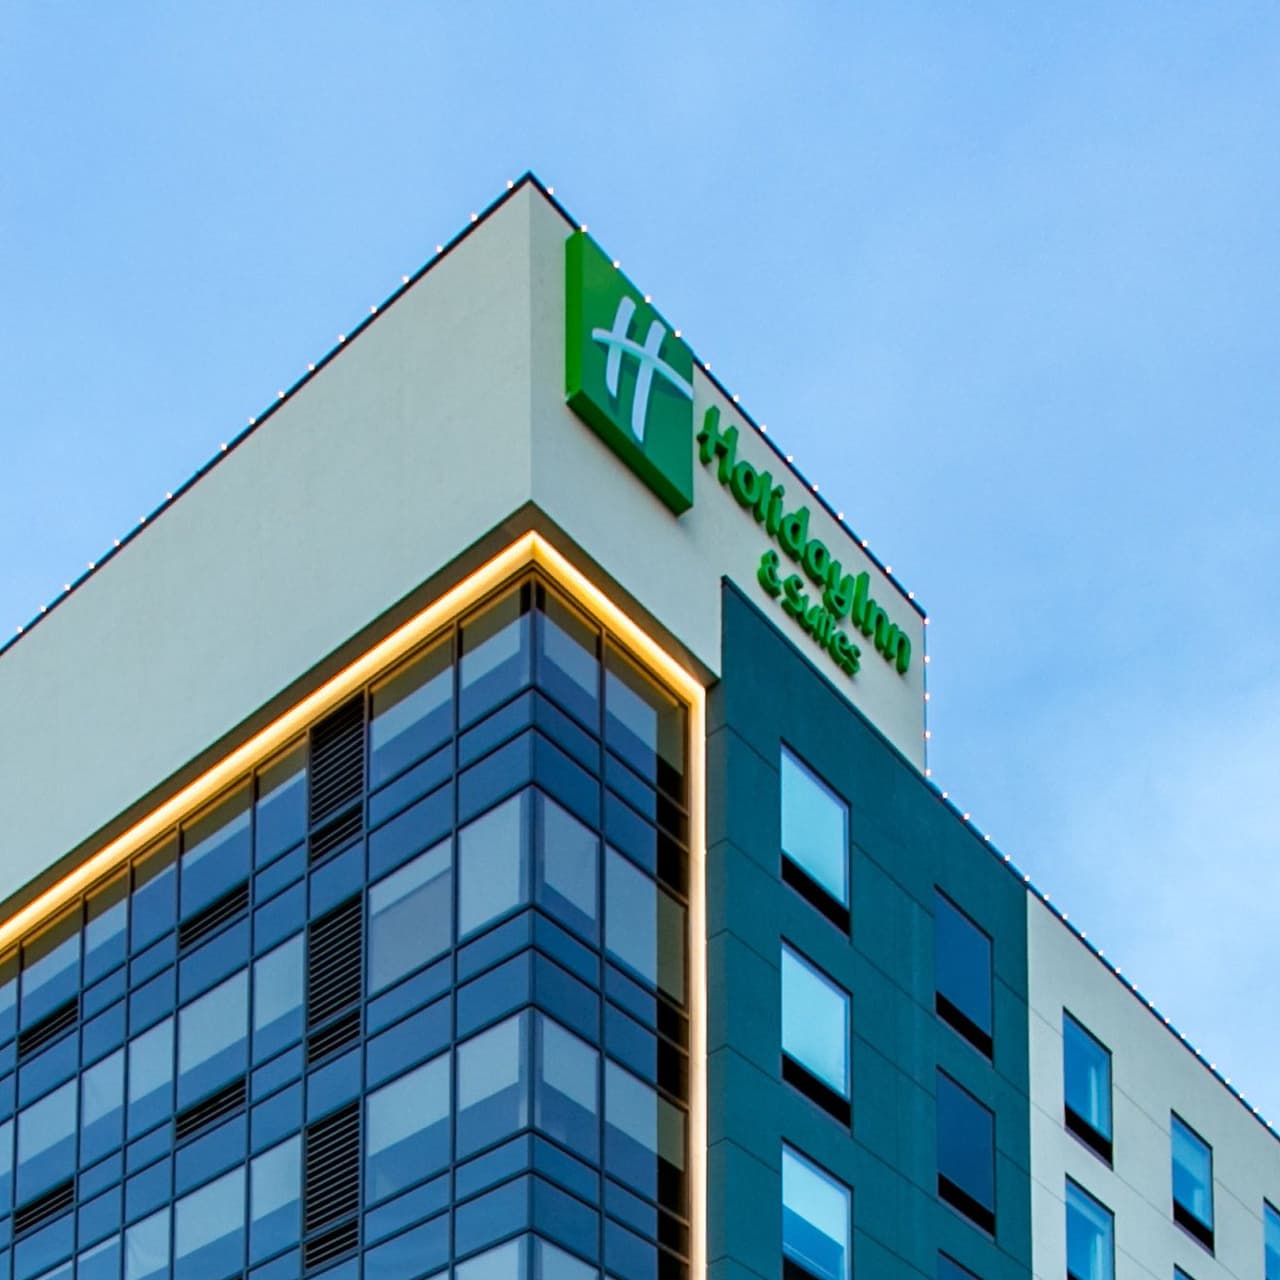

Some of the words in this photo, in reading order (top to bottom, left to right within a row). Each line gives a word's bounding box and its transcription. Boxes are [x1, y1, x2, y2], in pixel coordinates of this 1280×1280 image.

[697, 405, 854, 620] Holiday
[852, 571, 912, 675] Inn
[757, 549, 782, 598] &
[781, 574, 861, 677] Suites
